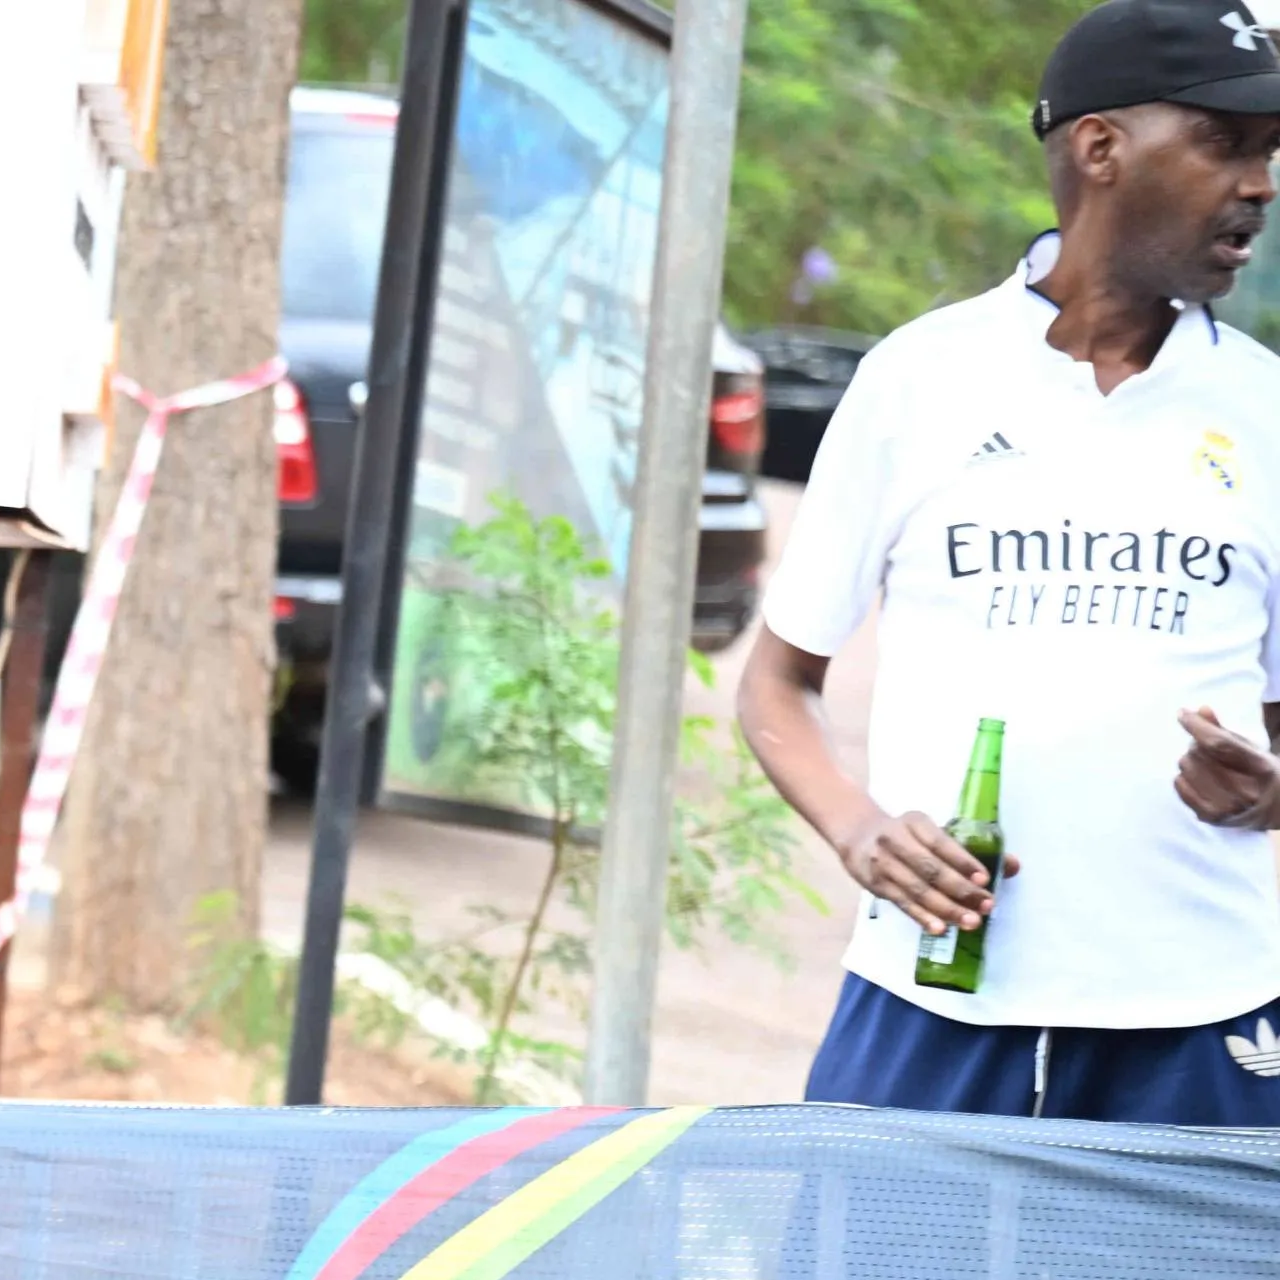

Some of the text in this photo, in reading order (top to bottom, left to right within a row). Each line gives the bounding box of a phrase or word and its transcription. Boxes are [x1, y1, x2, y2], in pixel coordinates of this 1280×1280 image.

[946, 519, 1237, 587] Emirates
[986, 584, 1189, 636] FLY BETTER
